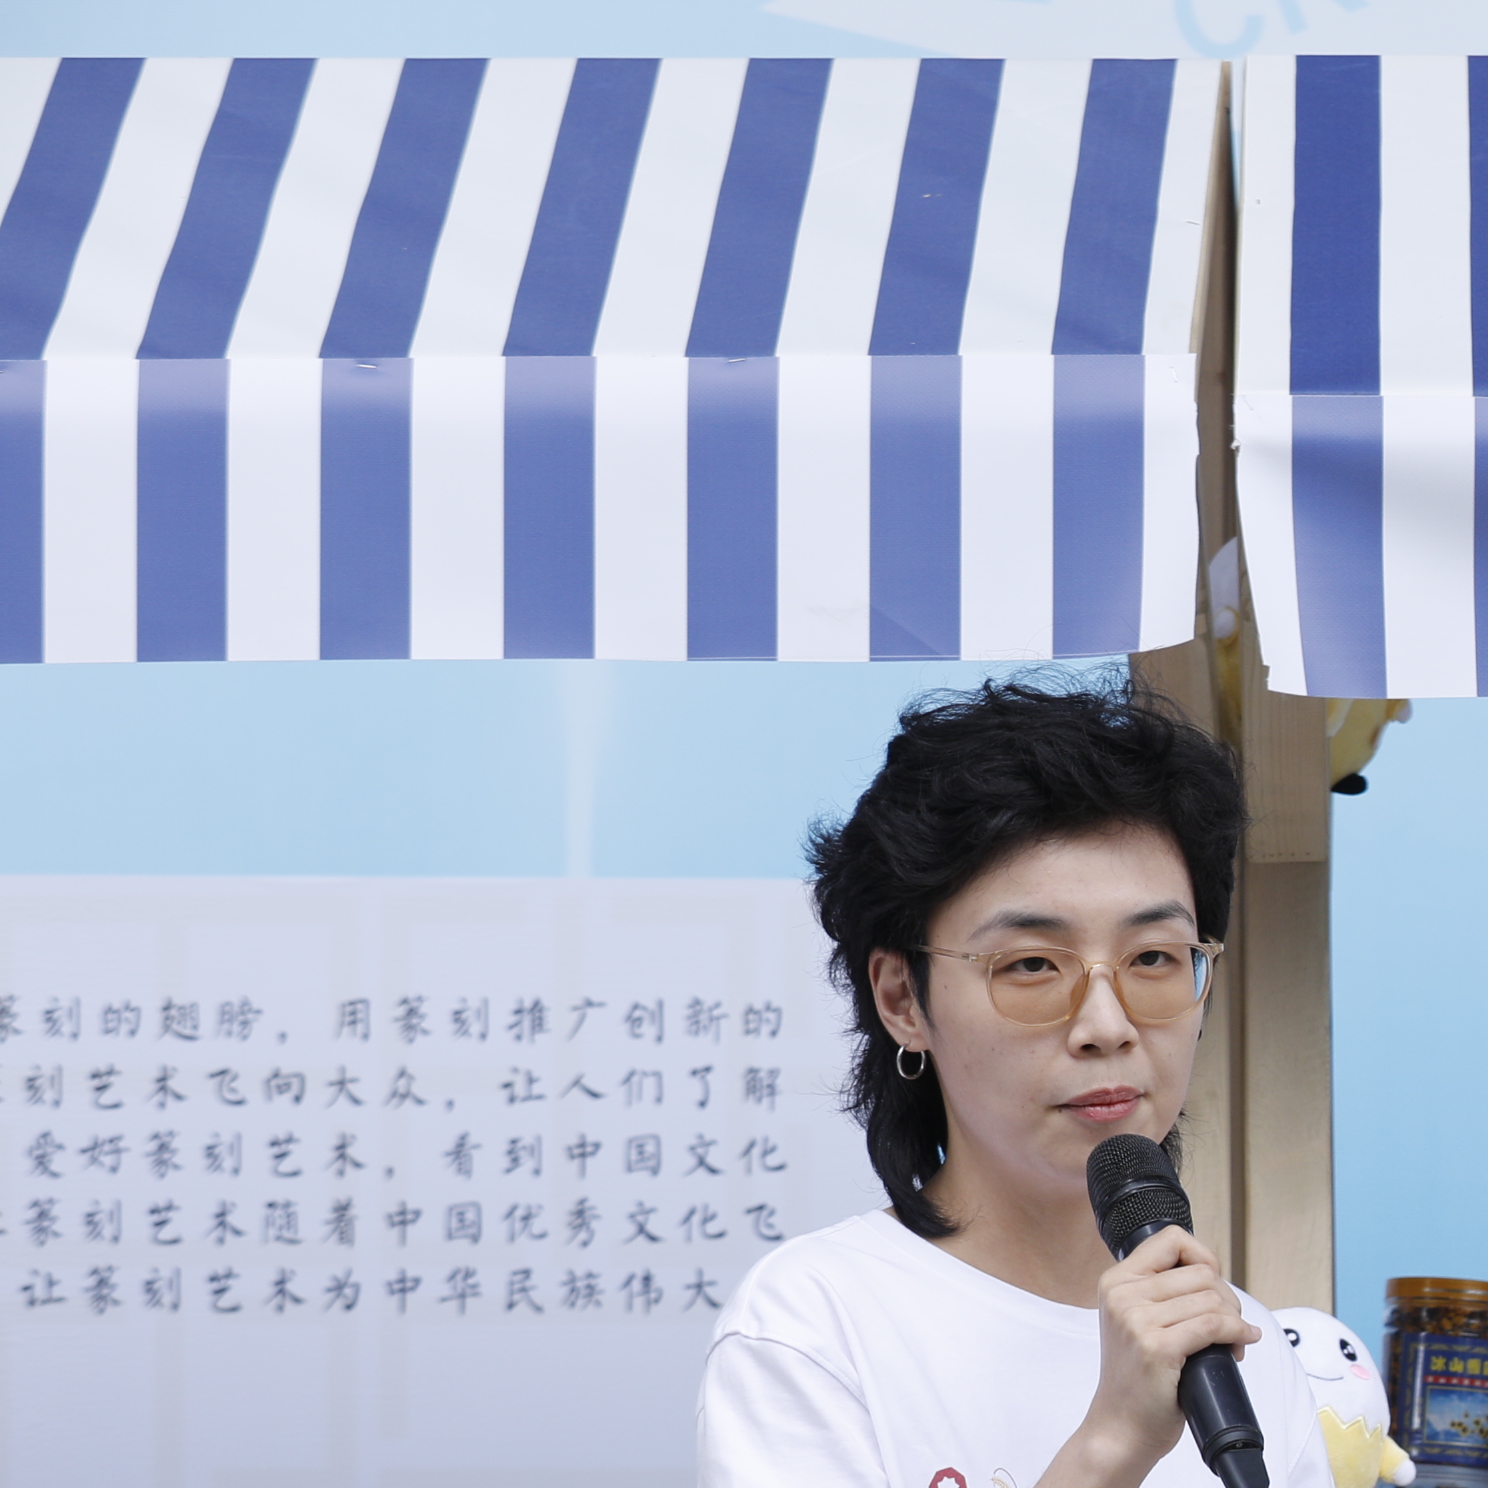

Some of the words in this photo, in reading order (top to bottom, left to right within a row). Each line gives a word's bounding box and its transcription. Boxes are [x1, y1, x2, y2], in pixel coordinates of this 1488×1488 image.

[0, 1066, 782, 1112] 刻艺术飞向大众，让人们了解
[0, 1200, 788, 1249] 篆刻艺术随着中国优秀文化飞
